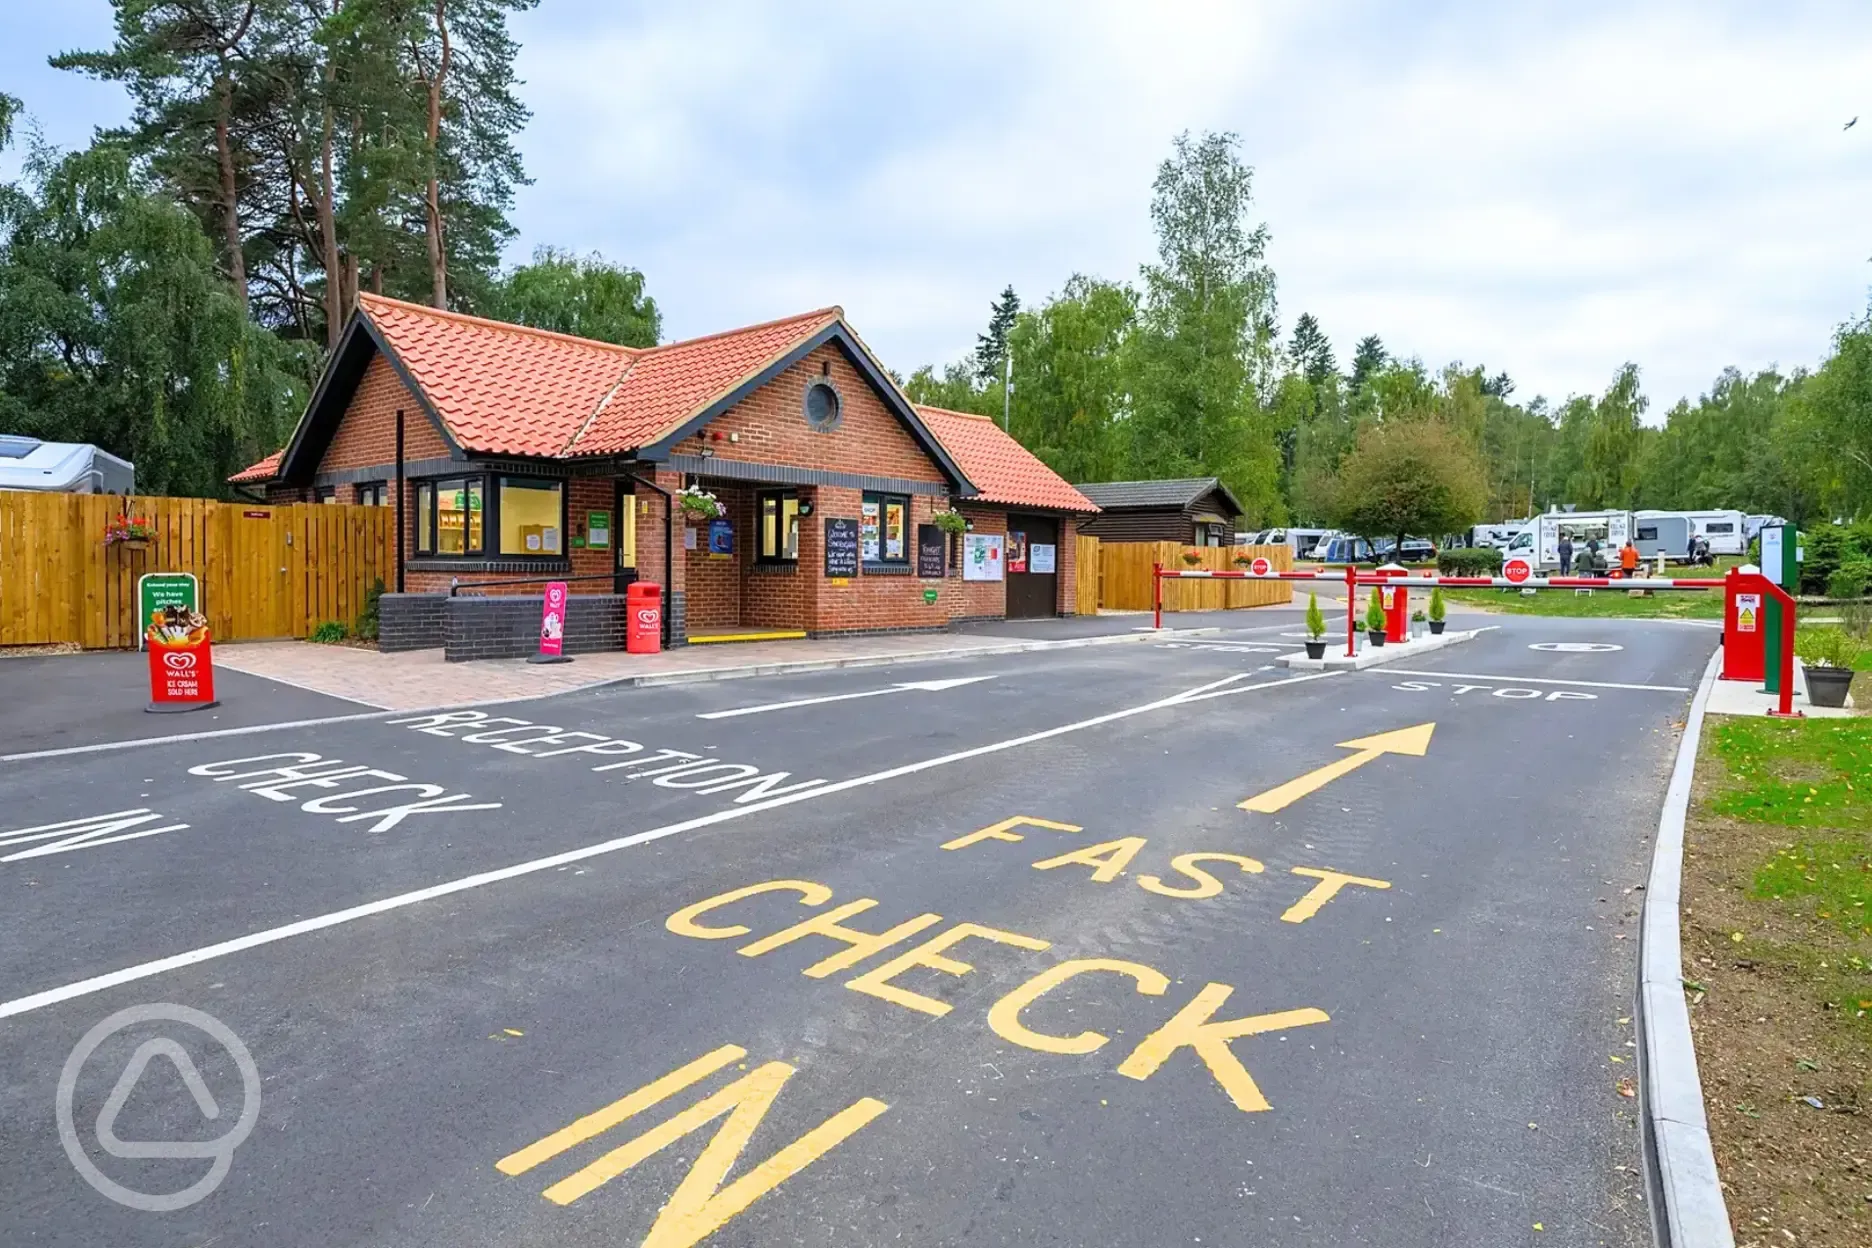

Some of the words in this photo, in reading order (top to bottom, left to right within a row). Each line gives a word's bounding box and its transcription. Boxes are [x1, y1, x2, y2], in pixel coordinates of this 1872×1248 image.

[1506, 567, 1528, 575] STOP
[166, 670, 197, 678] WALL'S
[167, 680, 176, 688] ICE
[177, 680, 198, 688] CREAM
[167, 688, 184, 696] SOLD
[184, 688, 199, 696] HERE
[1391, 680, 1599, 701] STOP
[384, 709, 829, 804] RECEPTION
[187, 752, 503, 834] CHECK
[940, 815, 1392, 923] FAST
[665, 880, 1332, 1113] CHECK
[494, 1043, 889, 1248] IN
